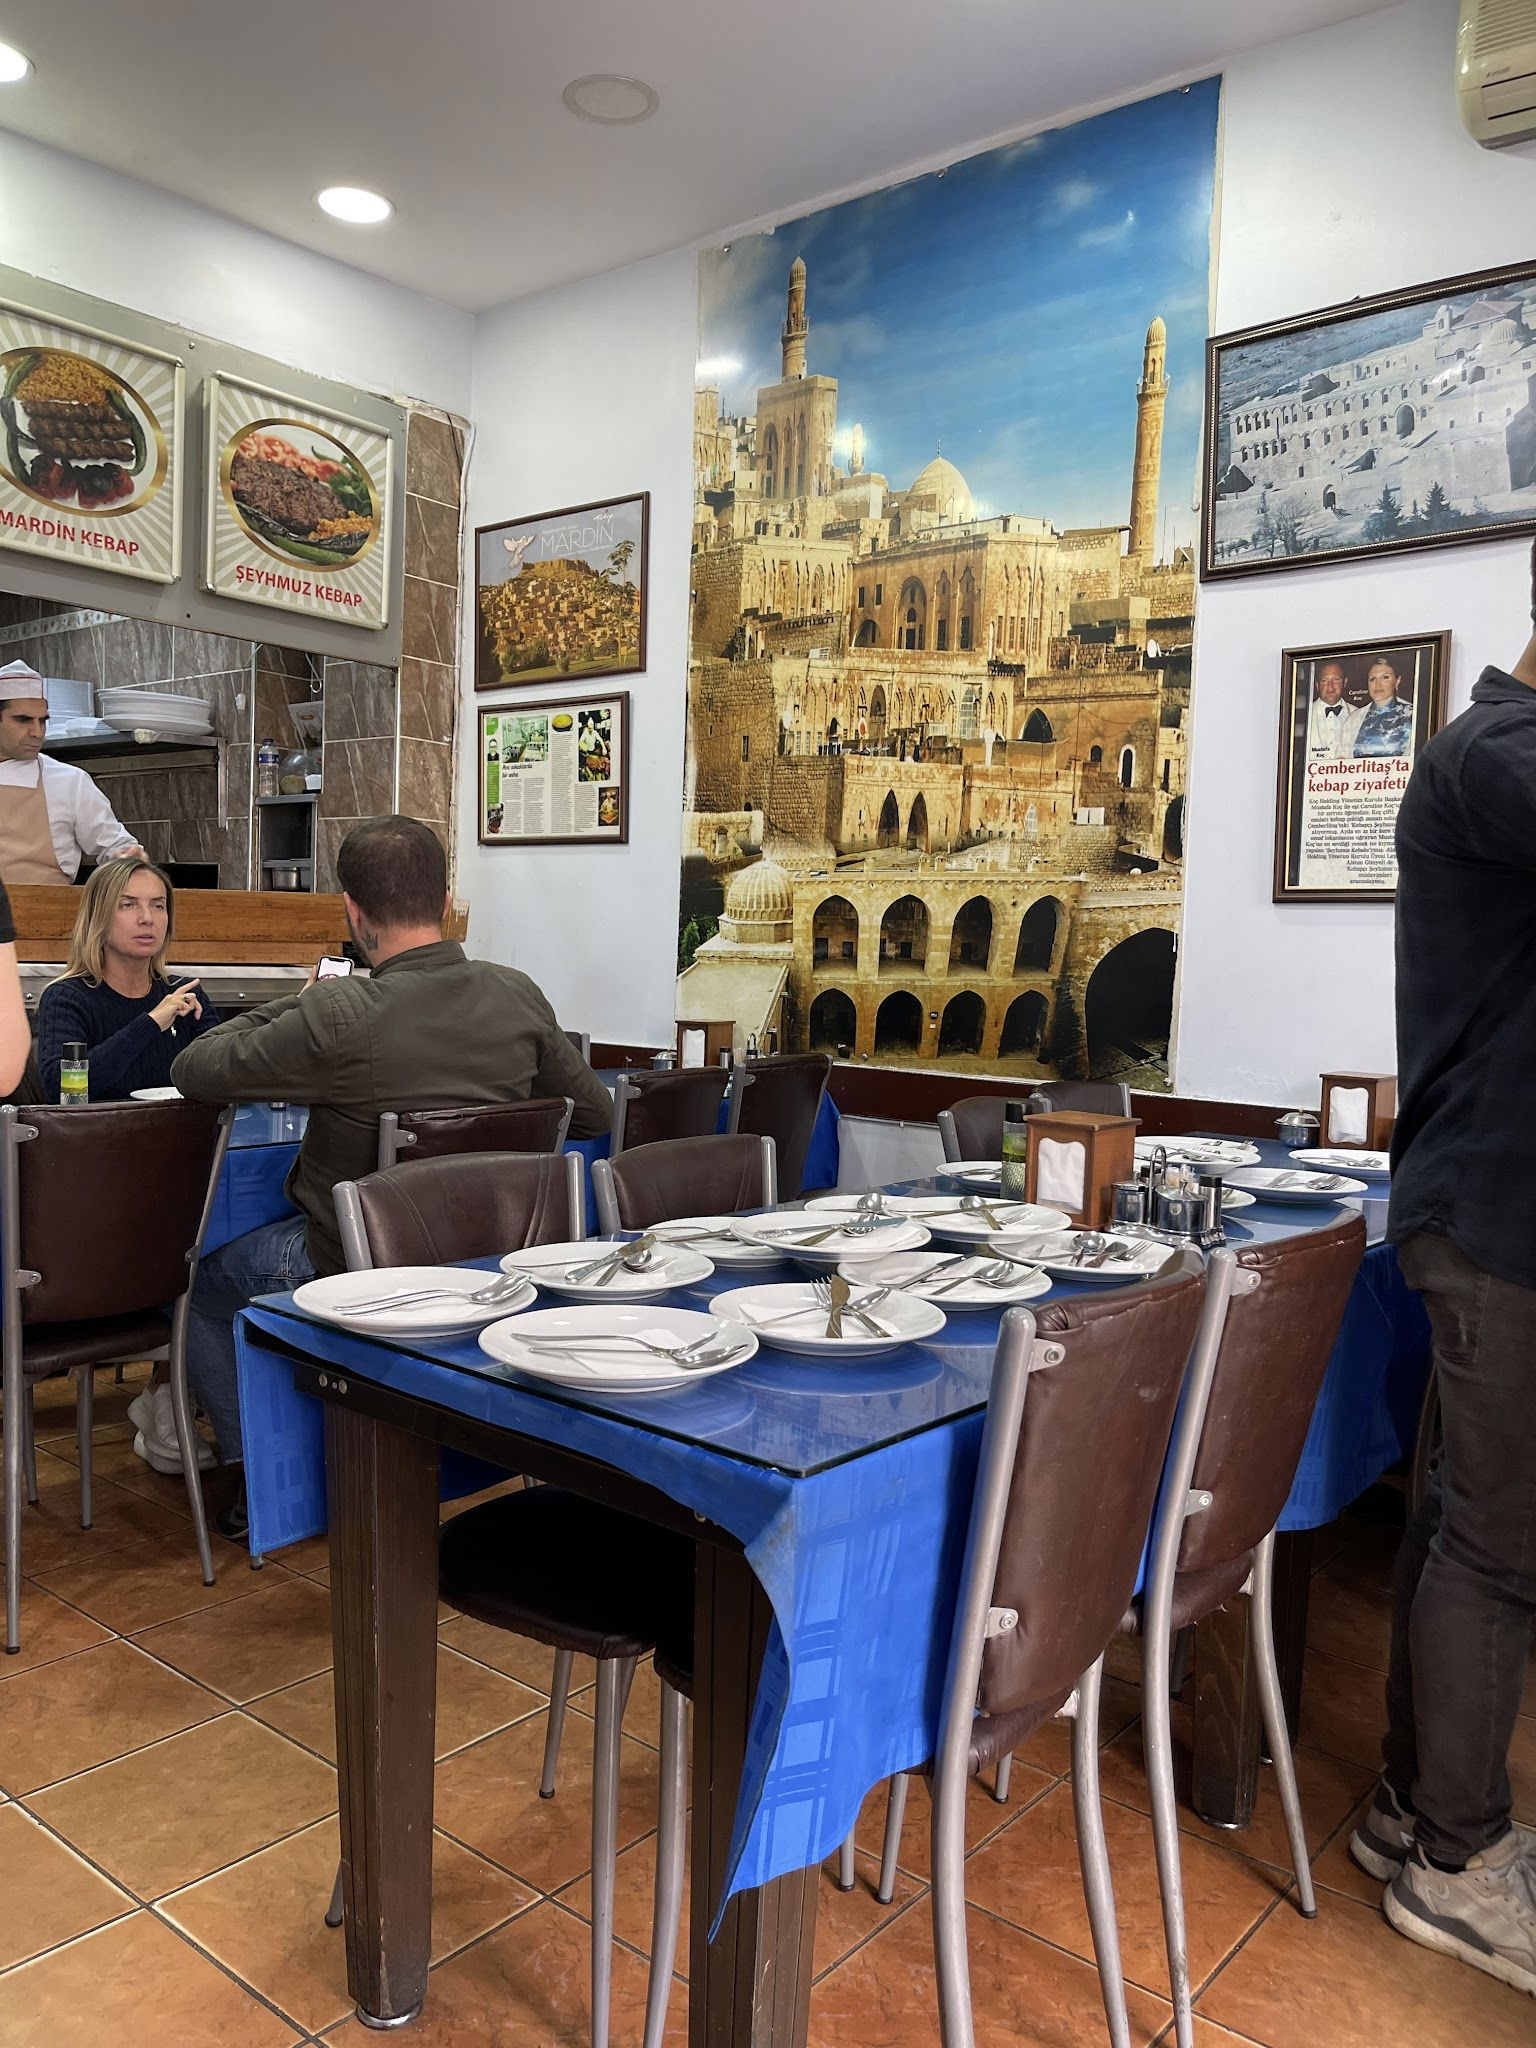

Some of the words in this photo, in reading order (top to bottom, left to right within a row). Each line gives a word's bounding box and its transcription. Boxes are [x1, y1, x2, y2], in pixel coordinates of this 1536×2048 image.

[80, 531, 140, 557] KEBAP
[235, 565, 312, 596] ŞEYHMUZ
[315, 584, 363, 608] KEBAP
[1307, 759, 1409, 778] Çemberlitaş'ta
[1308, 778, 1350, 795] kebap
[1353, 775, 1407, 795] ziyafeti
